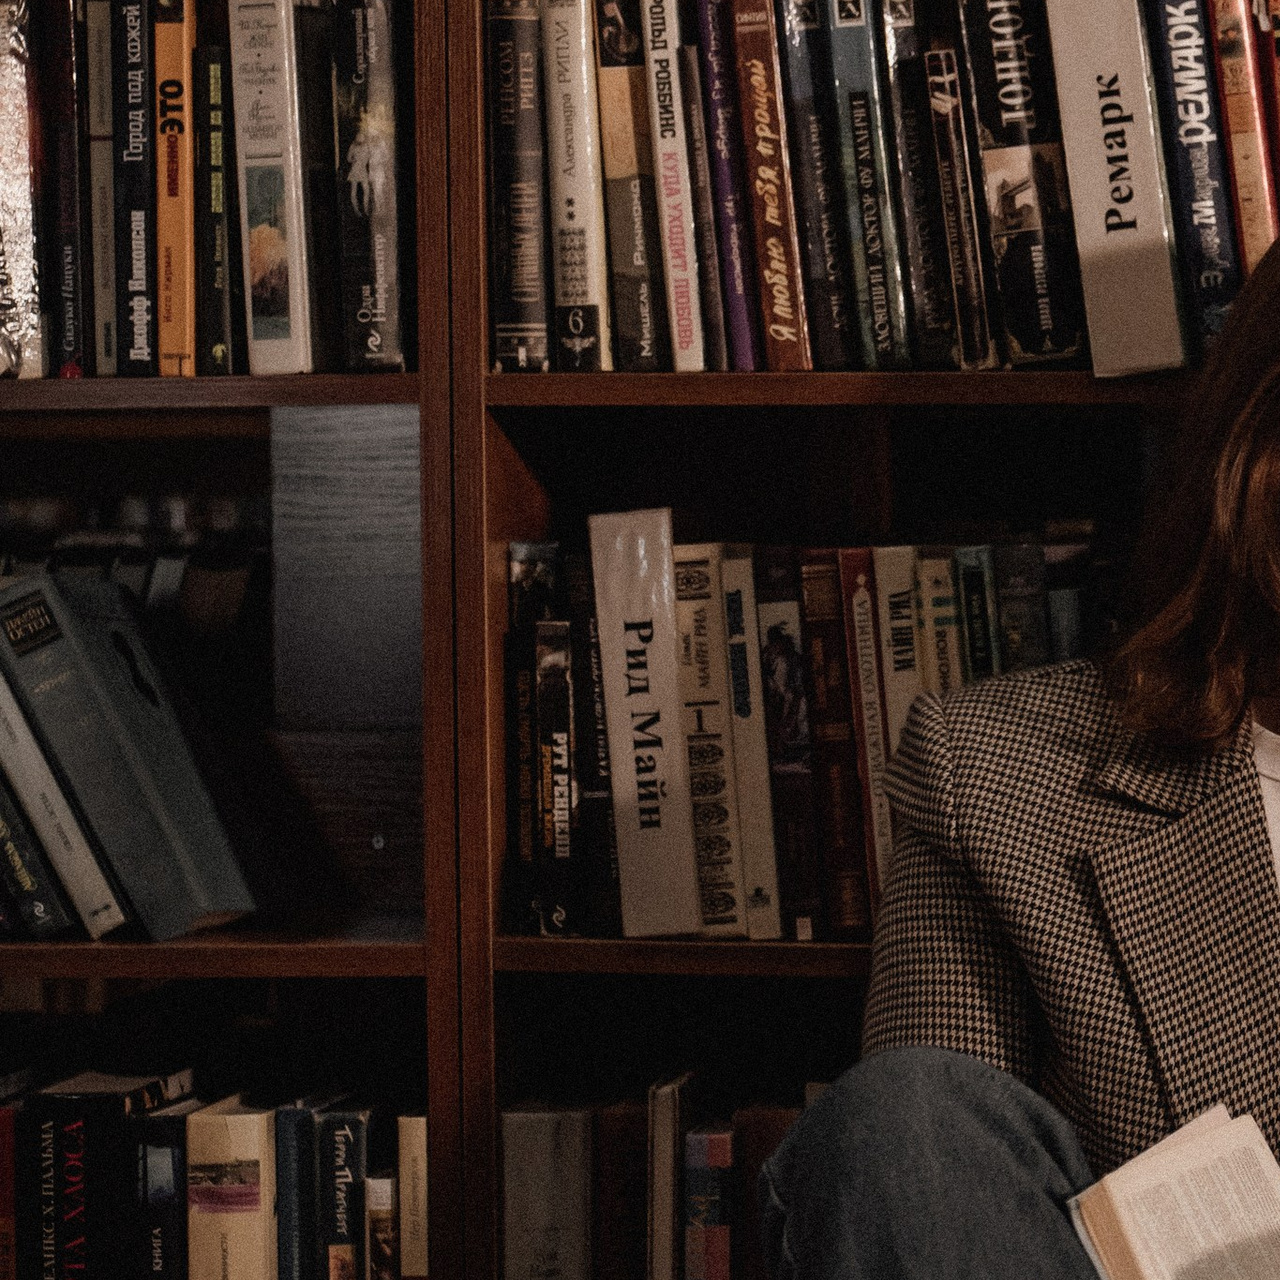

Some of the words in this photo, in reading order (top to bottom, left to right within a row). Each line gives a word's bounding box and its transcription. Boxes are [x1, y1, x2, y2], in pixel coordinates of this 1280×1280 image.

[121, 4, 142, 63] кожей
[552, 19, 571, 84] РИПЛИ
[127, 70, 145, 103] под
[159, 79, 184, 134] ЭТО
[652, 58, 677, 139] РОББИНС
[122, 109, 147, 162] Город
[1094, 73, 1138, 233] Ремарк
[662, 152, 680, 196] КУДА
[666, 201, 688, 271] УХОДИТ
[671, 276, 691, 350] ЛЮБОВЬ
[771, 325, 798, 341] Я
[623, 618, 654, 696] Рид
[553, 733, 570, 768] РУТ
[628, 711, 666, 829] Майн
[61, 1119, 87, 1223] ХАОСА
